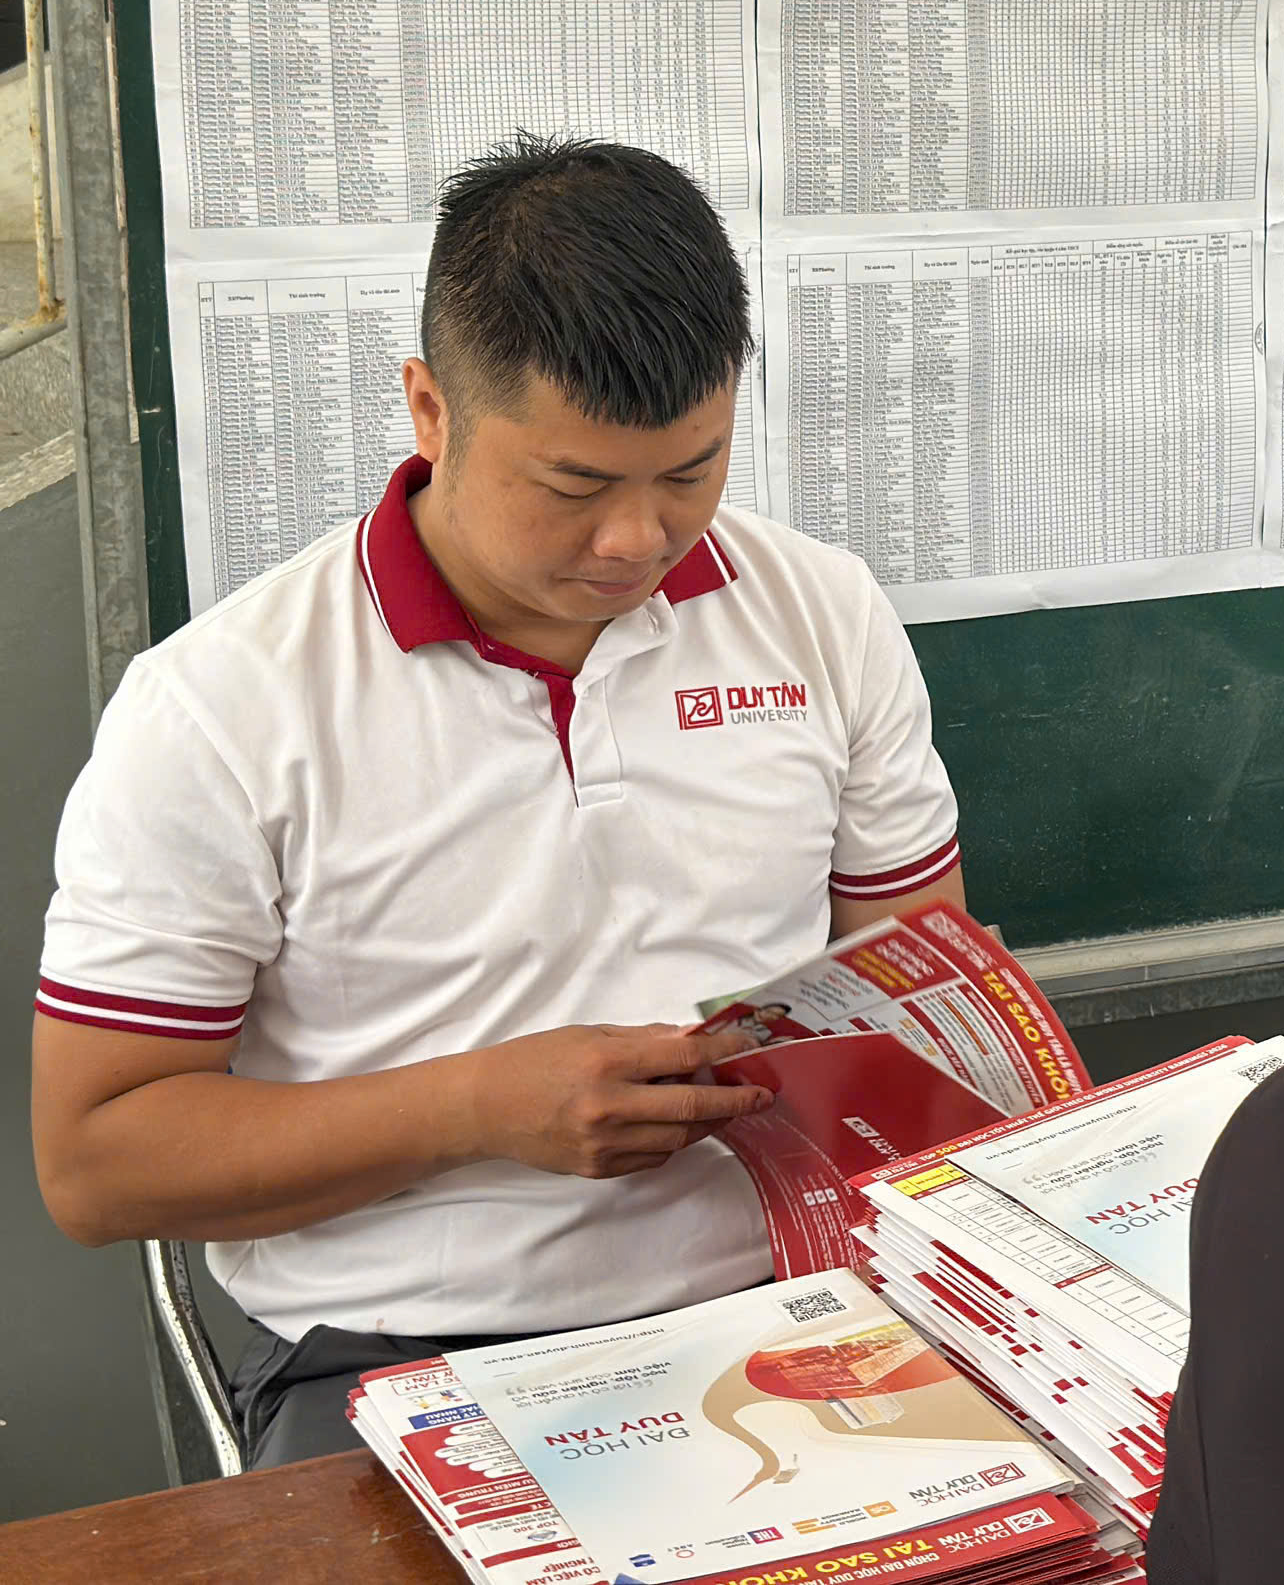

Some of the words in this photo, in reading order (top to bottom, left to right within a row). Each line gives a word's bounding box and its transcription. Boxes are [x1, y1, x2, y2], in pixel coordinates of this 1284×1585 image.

[726, 686, 764, 709] DUY
[766, 681, 806, 707] TÂN
[730, 709, 807, 724] UNIVERSITY
[1006, 997, 1042, 1047] SAO
[1150, 1178, 1202, 1203] DUY
[1172, 1197, 1197, 1211] ẠI
[1086, 1202, 1146, 1224] TÂN
[1109, 1209, 1170, 1234] HỌC
[621, 1412, 684, 1433] DUY
[544, 1427, 612, 1445] TÂN
[637, 1428, 689, 1445] ĐẠI
[560, 1439, 629, 1459] HỌC
[946, 1475, 977, 1489] DUY
[456, 1486, 494, 1499] TRUNG
[511, 1524, 533, 1534] 300
[536, 1519, 558, 1529] TOP
[971, 1519, 1004, 1537] DUY
[753, 1528, 776, 1541] THE
[883, 1540, 933, 1558] TẠI
[541, 1558, 587, 1573] NGHIỆP
[816, 1553, 877, 1572] SAO
[879, 1558, 902, 1573] ĐẠI
[901, 1550, 940, 1568] CHỌN
[826, 1570, 854, 1585] DUY
[852, 1563, 880, 1579] HỌC
